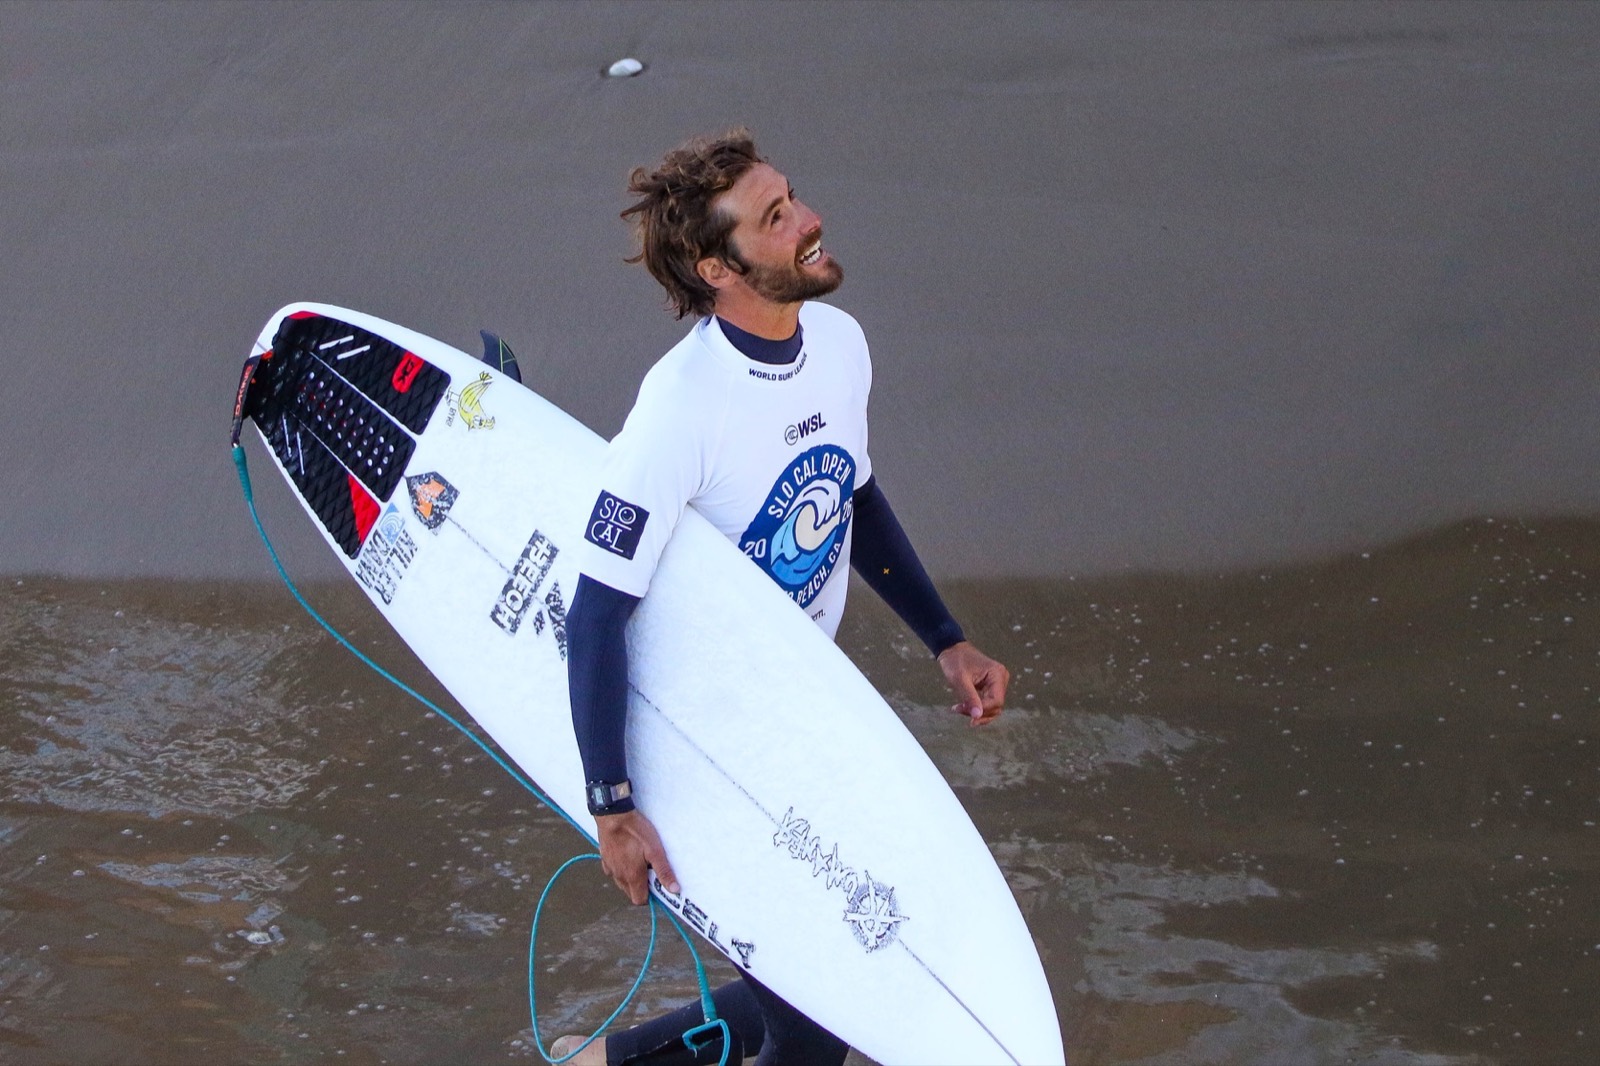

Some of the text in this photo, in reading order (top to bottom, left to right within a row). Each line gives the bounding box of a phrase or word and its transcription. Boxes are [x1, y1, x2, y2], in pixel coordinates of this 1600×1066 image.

[749, 368, 777, 381] WORLD
[778, 370, 794, 381] SURF
[798, 412, 826, 439] WSL
[768, 452, 852, 518] SLO CAL OPEN
[600, 498, 637, 531] SLO
[591, 520, 624, 553] CAL
[744, 538, 767, 558] 20
[828, 542, 841, 564] CA
